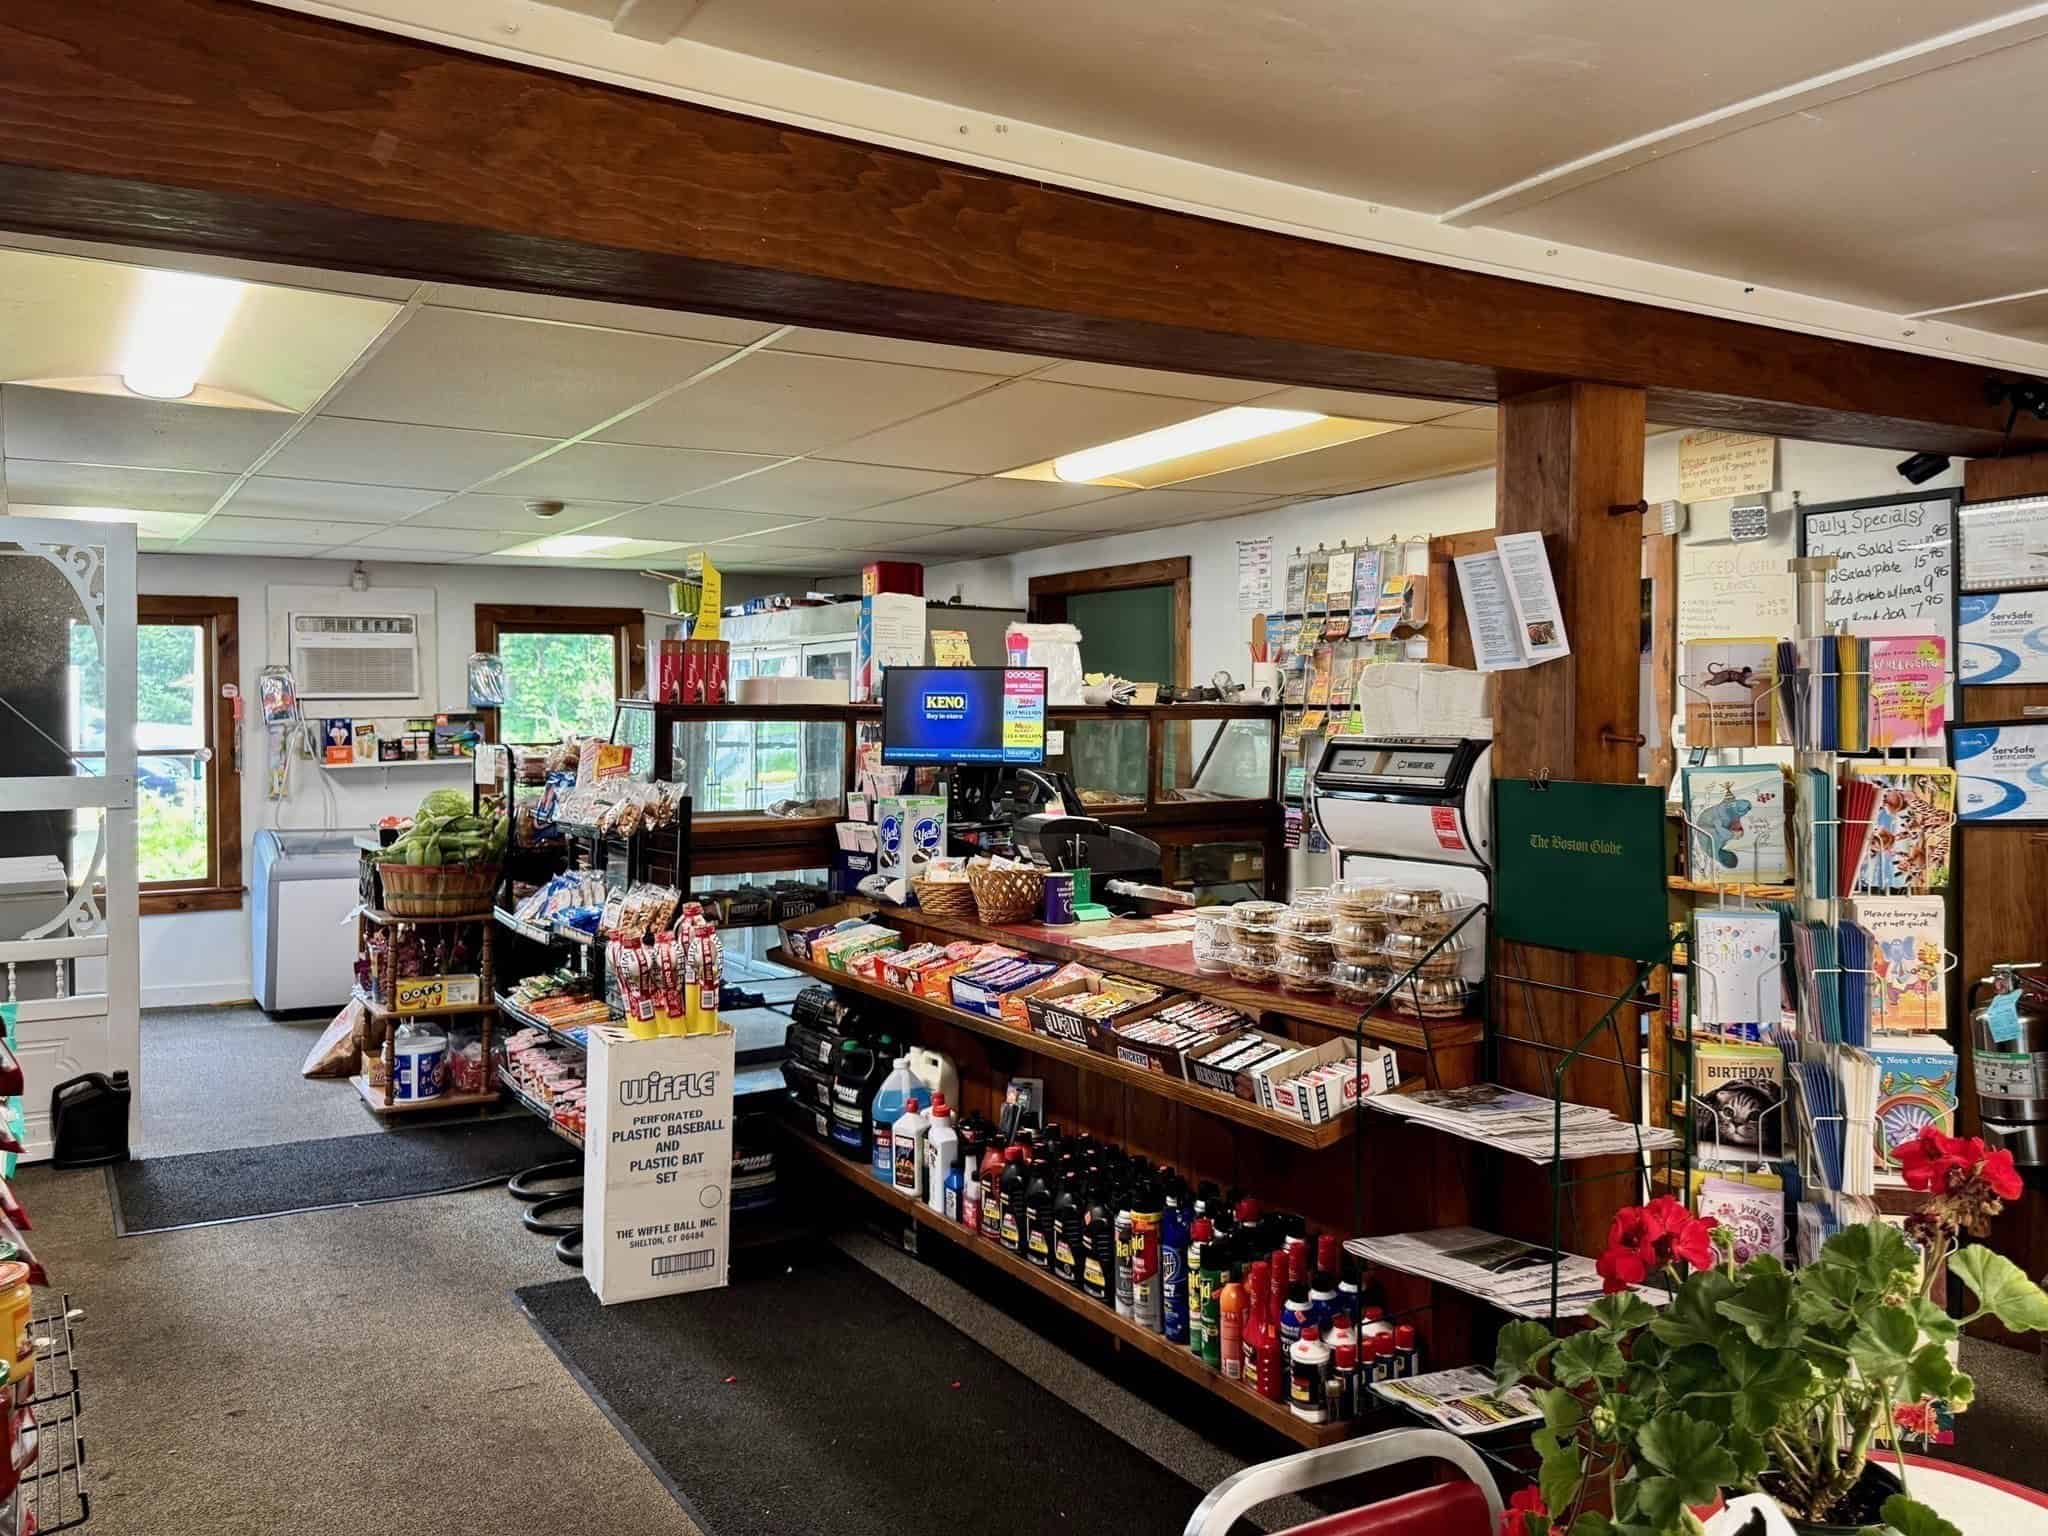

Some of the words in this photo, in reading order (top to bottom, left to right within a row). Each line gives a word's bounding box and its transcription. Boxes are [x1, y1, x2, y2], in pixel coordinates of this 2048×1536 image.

[1807, 516, 1846, 535] Daily
[1857, 541, 1894, 558] Salad
[1838, 566, 1872, 583] Salad
[1990, 609, 2033, 621] ServSafe
[926, 695, 964, 710] KENO
[1992, 744, 2035, 755] ServSafe
[1529, 834, 1549, 849] The
[1552, 835, 1589, 852] Boston
[1590, 839, 1623, 856] Globe
[1863, 910, 1893, 918] Please
[1894, 910, 1919, 921] hurry
[1872, 920, 1887, 930] get
[1890, 920, 1905, 928] well
[401, 982, 443, 1002] DOTS
[1119, 1047, 1148, 1067] SNICKERS
[1887, 1056, 1909, 1065] Note
[1911, 1056, 1922, 1065] of
[1194, 1064, 1235, 1092] HERSHEY'S
[1707, 1066, 1775, 1079] BIRTHDAY
[620, 1071, 714, 1105] WIFFLE
[633, 1109, 703, 1126] PERFORATED
[612, 1127, 661, 1142] PLASTIC
[667, 1119, 724, 1137] BASEBALL
[656, 1140, 680, 1153] AND
[630, 1156, 679, 1172] PLASTIC
[682, 1152, 704, 1165] BAT
[656, 1171, 678, 1184] SET
[616, 1229, 634, 1240] THE
[638, 1223, 671, 1237] WIFFLE
[674, 1220, 697, 1232] BALL
[700, 1217, 718, 1228] INC.
[630, 1239, 665, 1248] SHELTON,
[667, 1235, 677, 1243] CT
